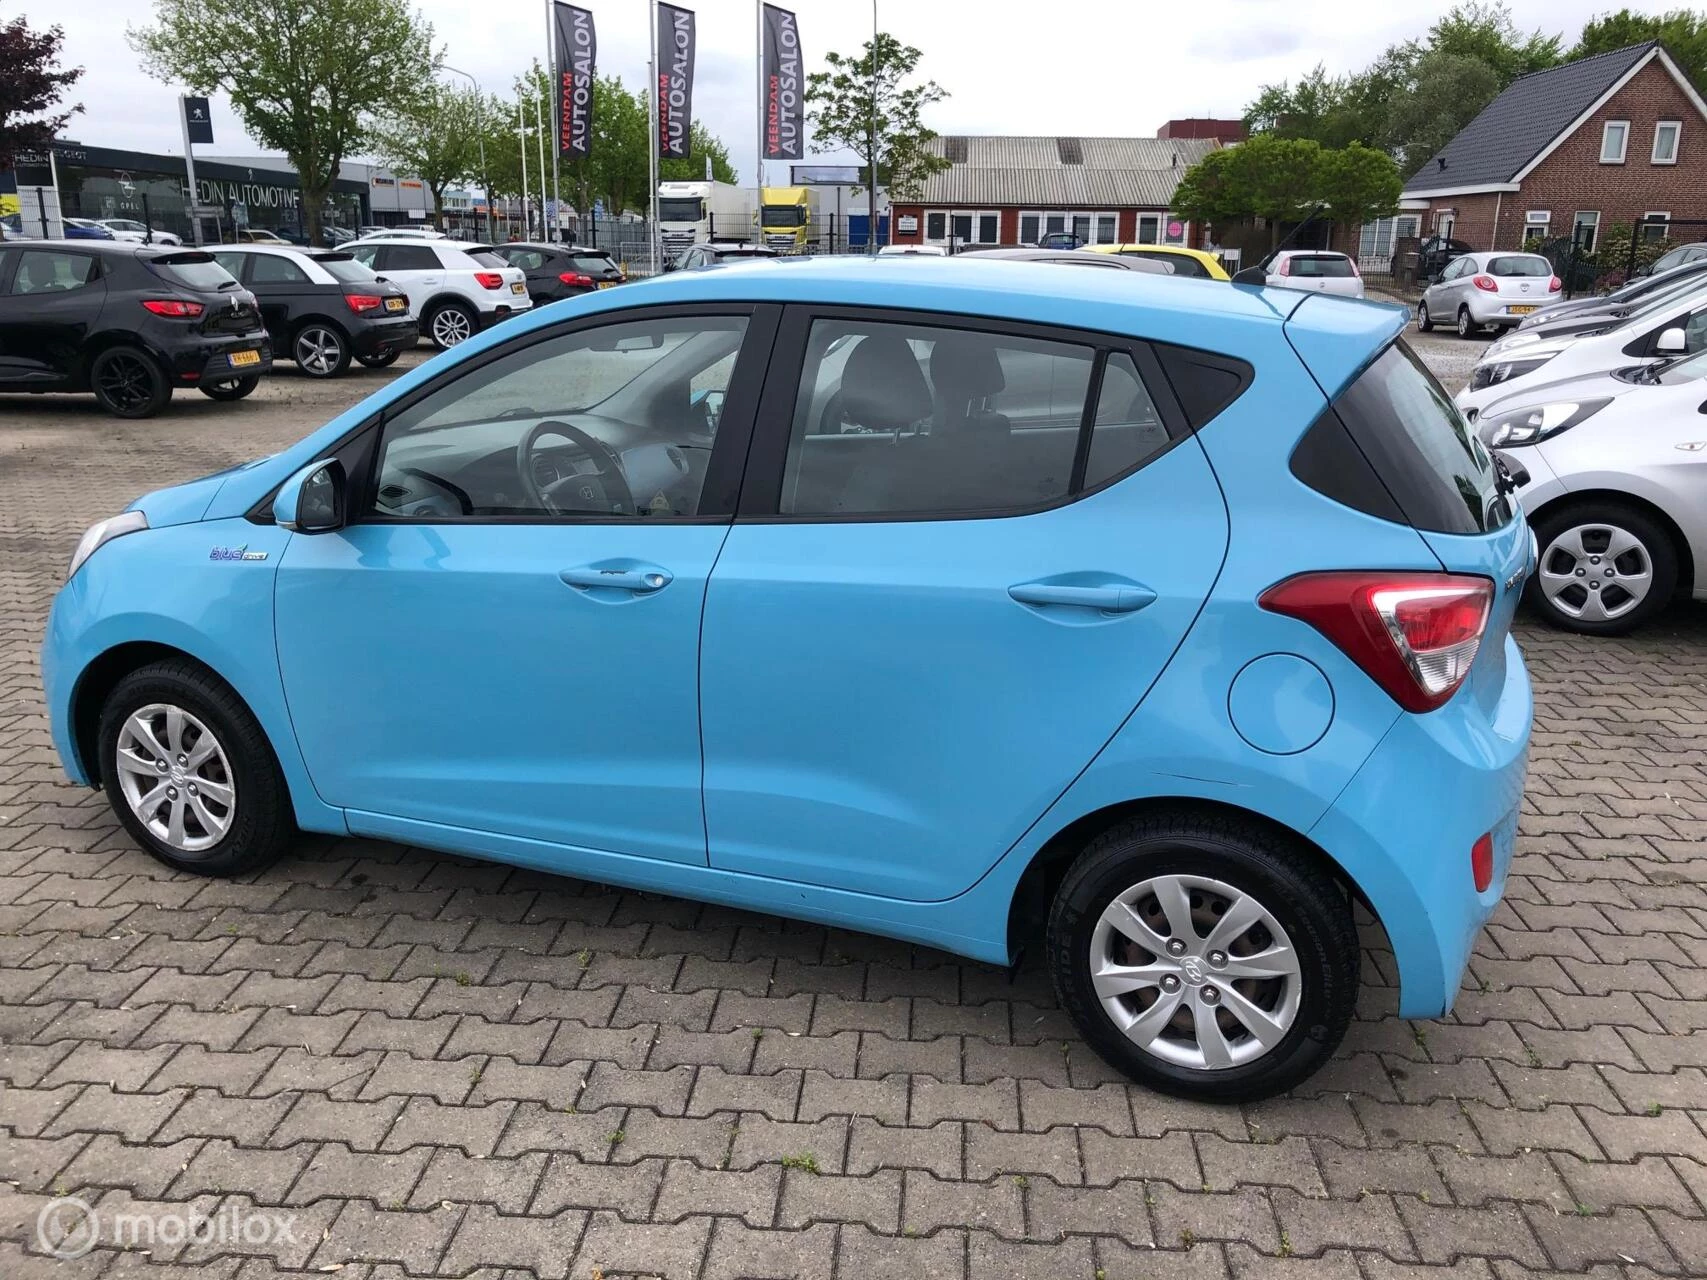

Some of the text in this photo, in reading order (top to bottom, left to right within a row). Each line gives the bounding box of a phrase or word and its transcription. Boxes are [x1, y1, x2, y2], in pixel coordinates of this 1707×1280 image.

[562, 72, 573, 150] VEENDAM
[572, 10, 592, 153] AUTOSALON
[659, 73, 670, 152] VEENDAM
[668, 10, 691, 155] AUTOSALON
[768, 75, 780, 155] VEENDAM
[779, 12, 799, 156] AUTOSALON
[228, 182, 300, 209] AUTOMOTIVE
